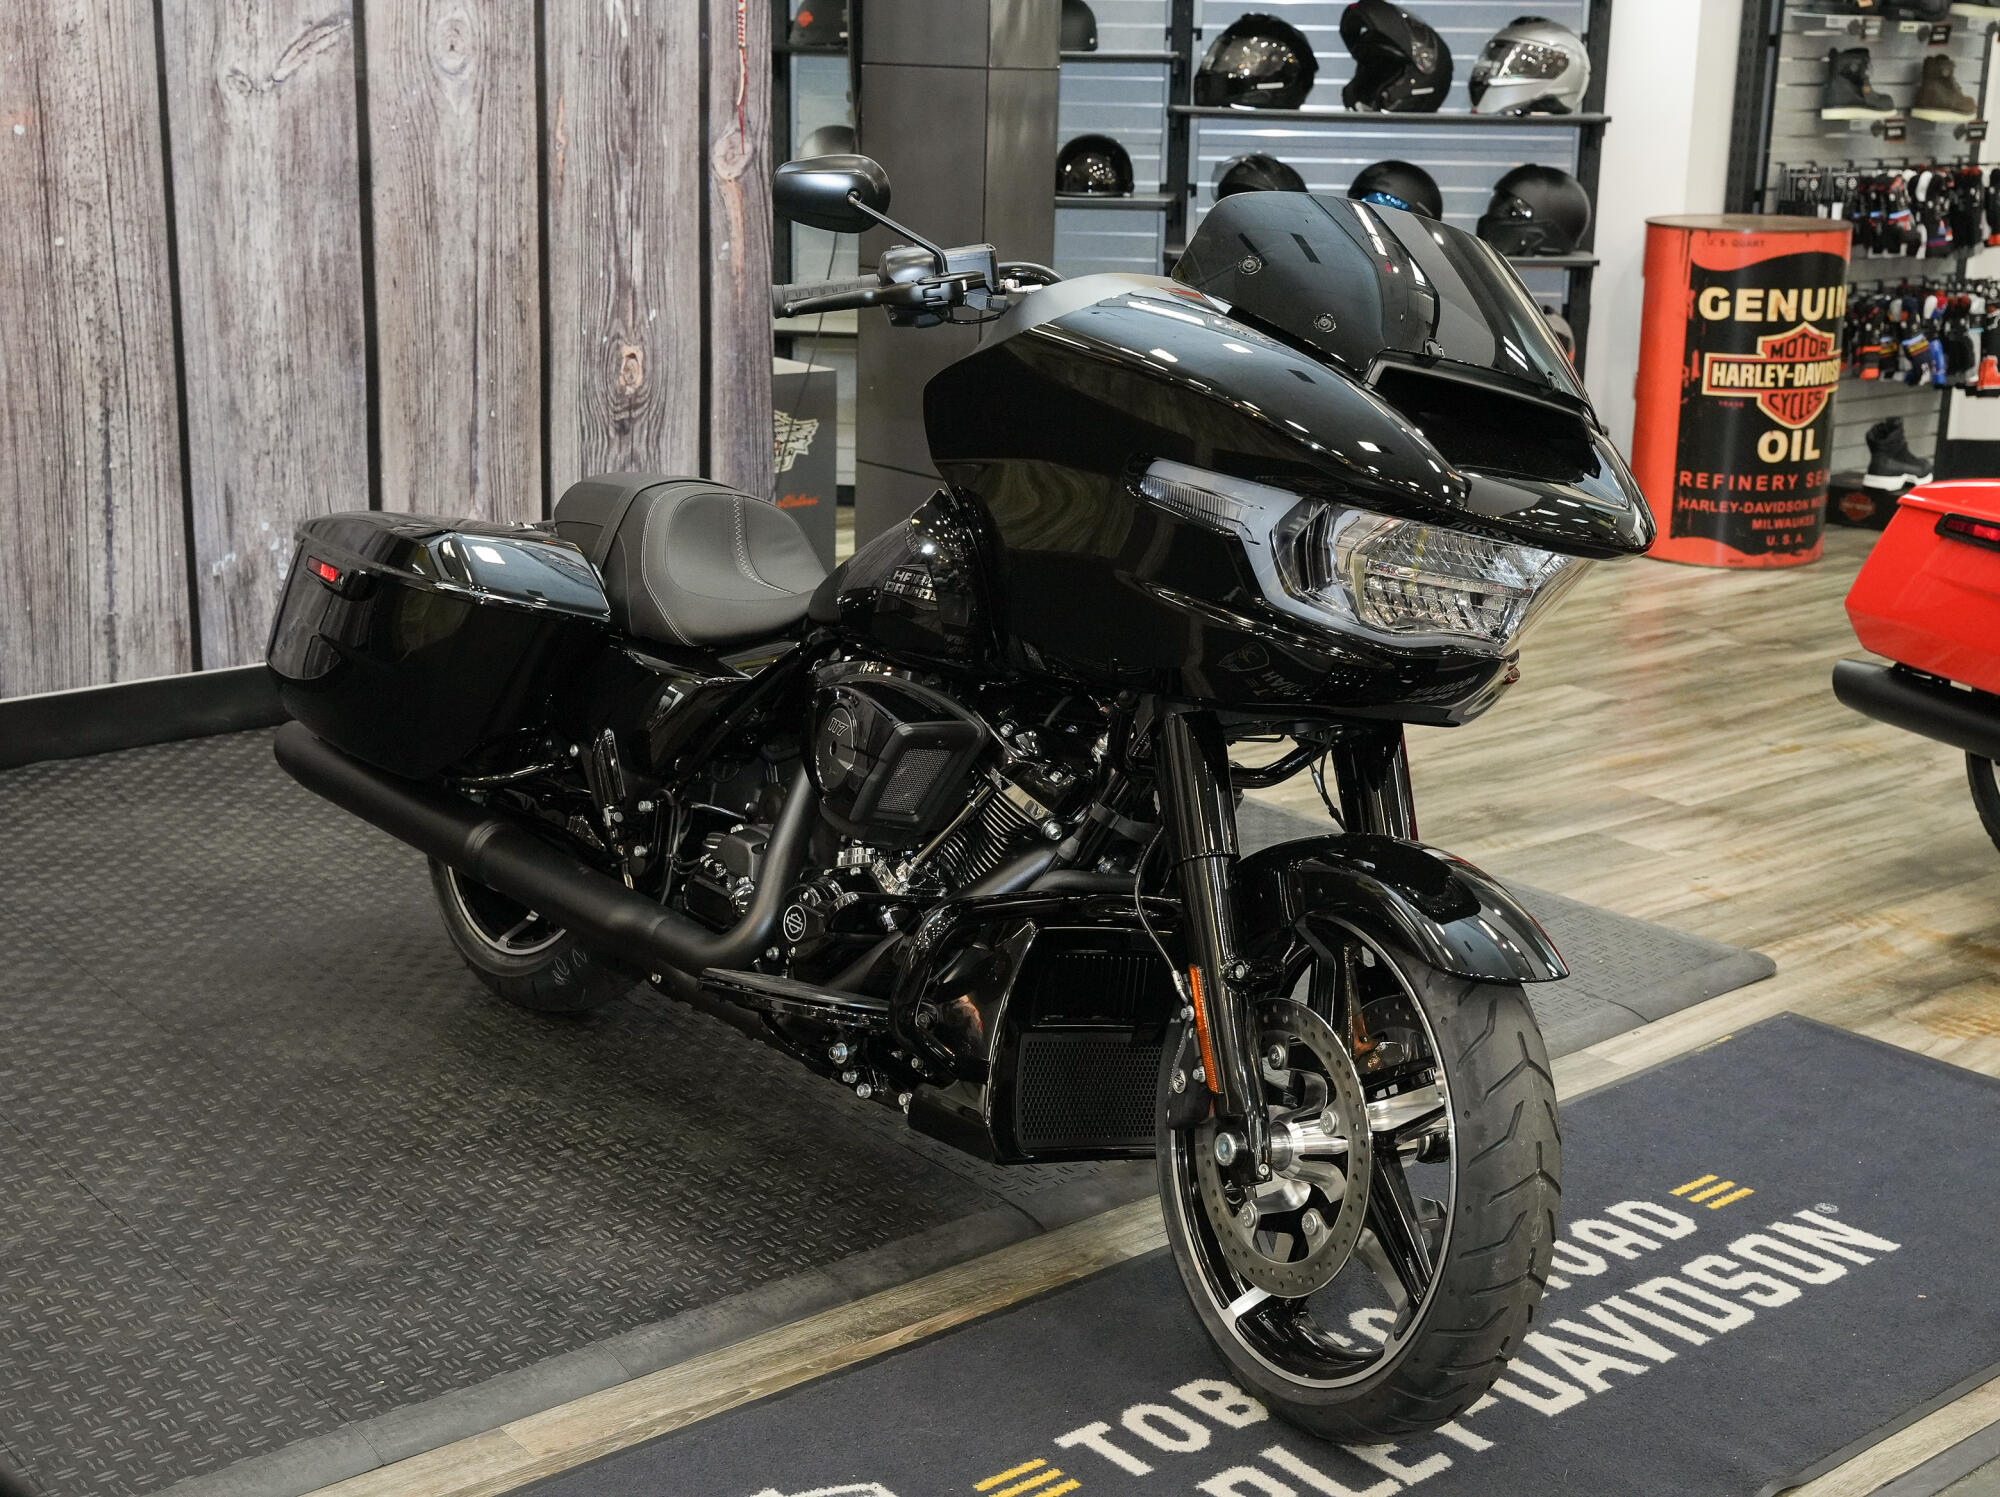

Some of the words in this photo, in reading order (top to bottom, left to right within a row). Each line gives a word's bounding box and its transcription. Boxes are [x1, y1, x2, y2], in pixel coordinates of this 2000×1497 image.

[1771, 334, 1829, 359] MOTOR
[1768, 390, 1823, 421] CYCLES
[1757, 429, 1821, 464] OIL
[1679, 470, 1799, 491] REFINERY
[1678, 496, 1809, 514] HARLEY-DAVIDSON
[828, 717, 850, 737] 117
[1541, 1200, 1699, 1300] OAD
